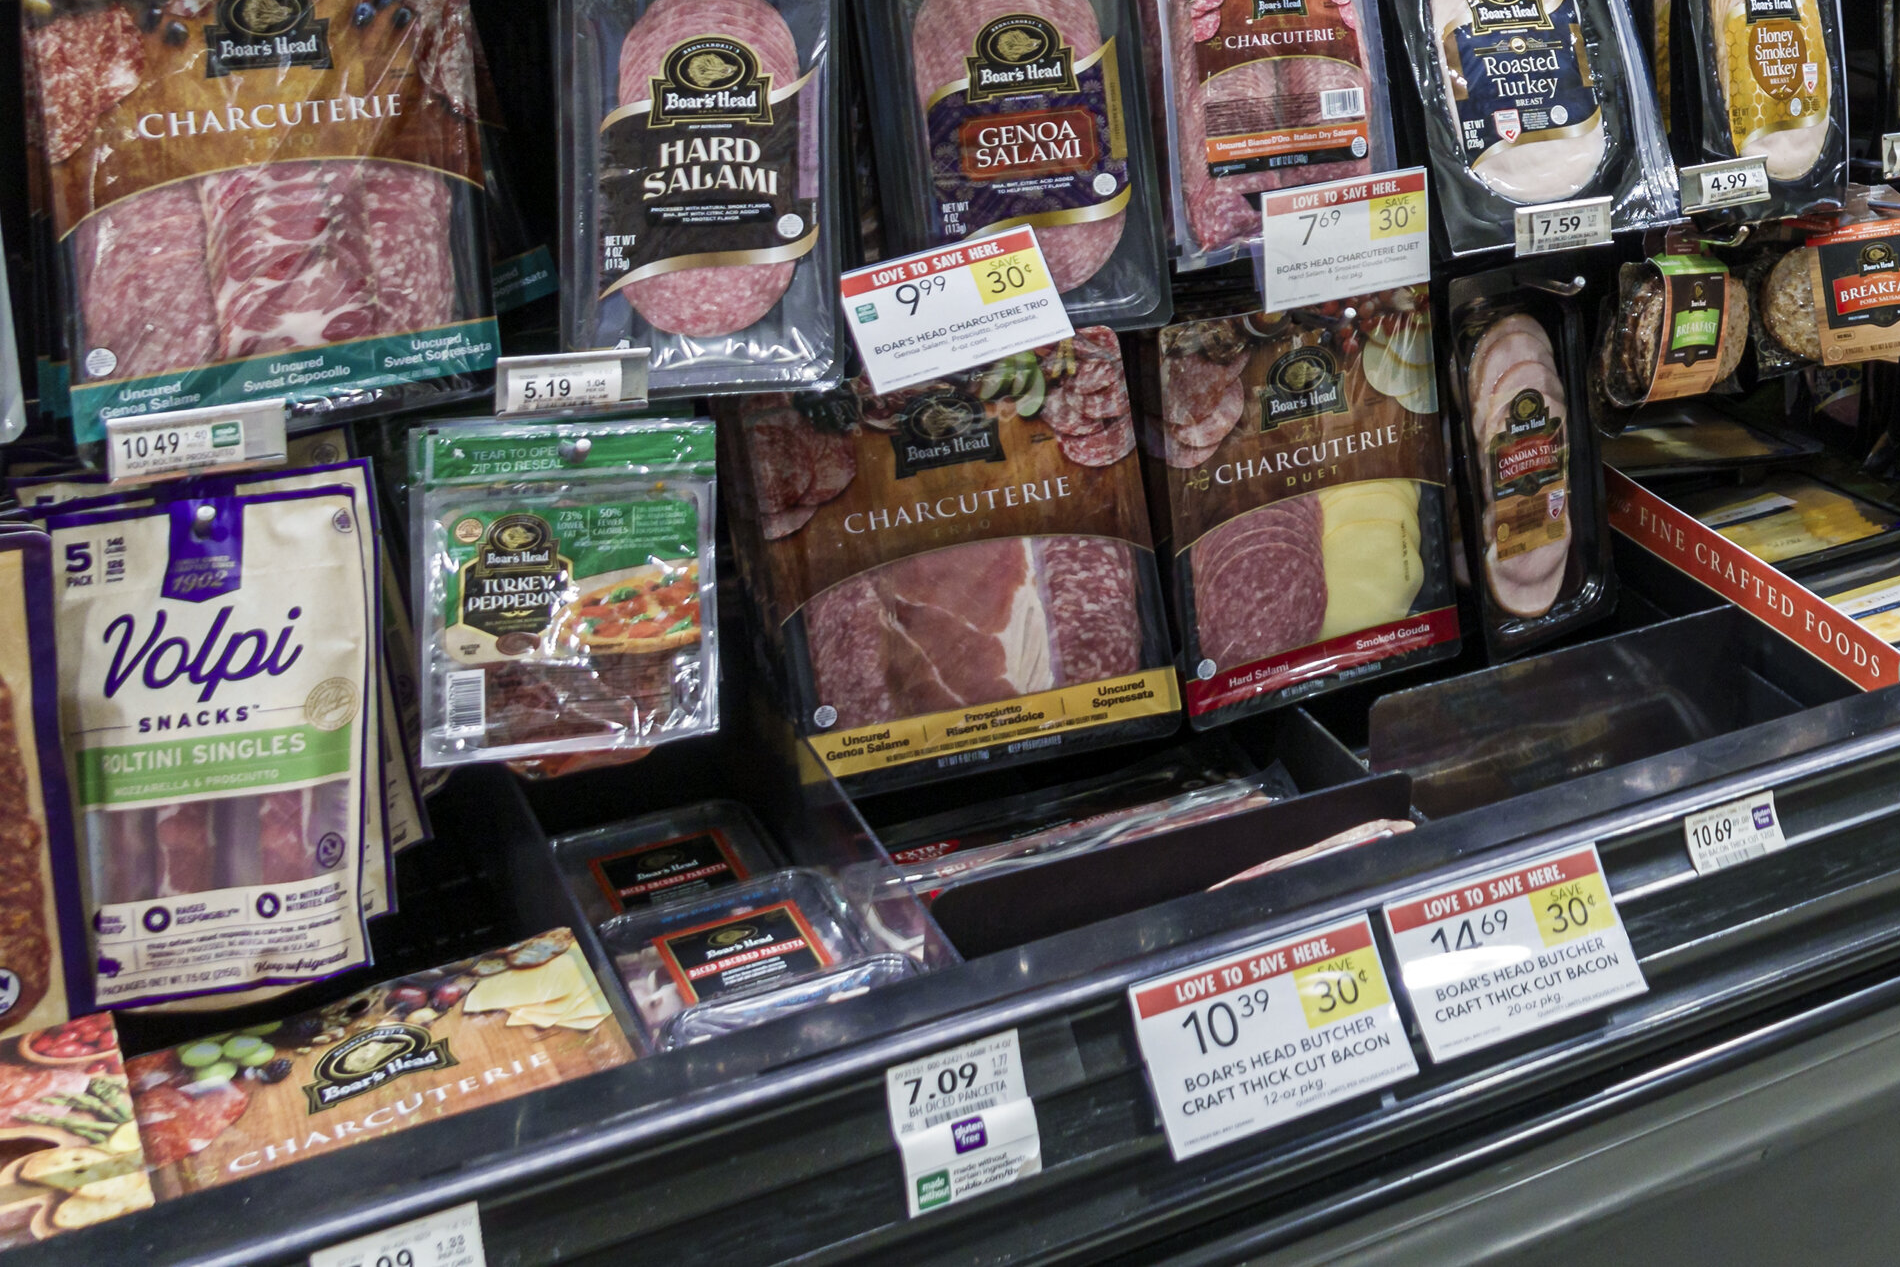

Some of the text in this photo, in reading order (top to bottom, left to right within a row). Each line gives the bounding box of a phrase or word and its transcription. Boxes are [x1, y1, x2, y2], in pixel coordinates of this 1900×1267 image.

[1224, 27, 1335, 50] CHARCUTERIE
[1754, 42, 1800, 61] Smoked
[1757, 29, 1794, 48] Honey
[1482, 53, 1560, 76] Roasted
[1760, 60, 1798, 80] Turkey
[1492, 75, 1559, 100] Turkey
[1515, 97, 1545, 106] BREAST
[137, 93, 403, 139] CHARCUTERIE
[977, 121, 1073, 149] GENOA
[659, 136, 762, 168] HARD
[975, 138, 1083, 169] SALAMI
[642, 166, 777, 202] SALAMI
[1711, 173, 1747, 192] 4.99
[1540, 216, 1581, 235] 7.59
[1859, 294, 1881, 305] PORK
[244, 363, 351, 393] Sweet Capocollo
[270, 356, 324, 374] Uncured
[524, 378, 572, 399] 5.19
[1214, 425, 1398, 484] CHARCUTERIE
[1286, 465, 1339, 487] DUET
[65, 542, 92, 572] 5
[66, 575, 93, 587] PACK
[172, 570, 228, 593] 1902
[483, 575, 553, 594] TURKEY
[1639, 507, 1881, 677] FINE CRAFTED FOODS
[1356, 623, 1430, 650] Smoked Gouda
[102, 605, 303, 704] Volpi
[1228, 661, 1290, 688] Hard Salami
[138, 706, 249, 732] SNACKS
[192, 732, 306, 763] SINGLES
[1691, 816, 1733, 850] 10.69
[1184, 1015, 1376, 1094] BOAR'S HEAD BUTCHER
[904, 1062, 978, 1105] 7.09
[1182, 1082, 1240, 1116] CRAFT
[1242, 1067, 1290, 1096] THICK
[1294, 1054, 1328, 1076] CUT
[1331, 1032, 1391, 1065] BACON
[908, 1079, 1008, 1118] BH DICED PANCETTA
